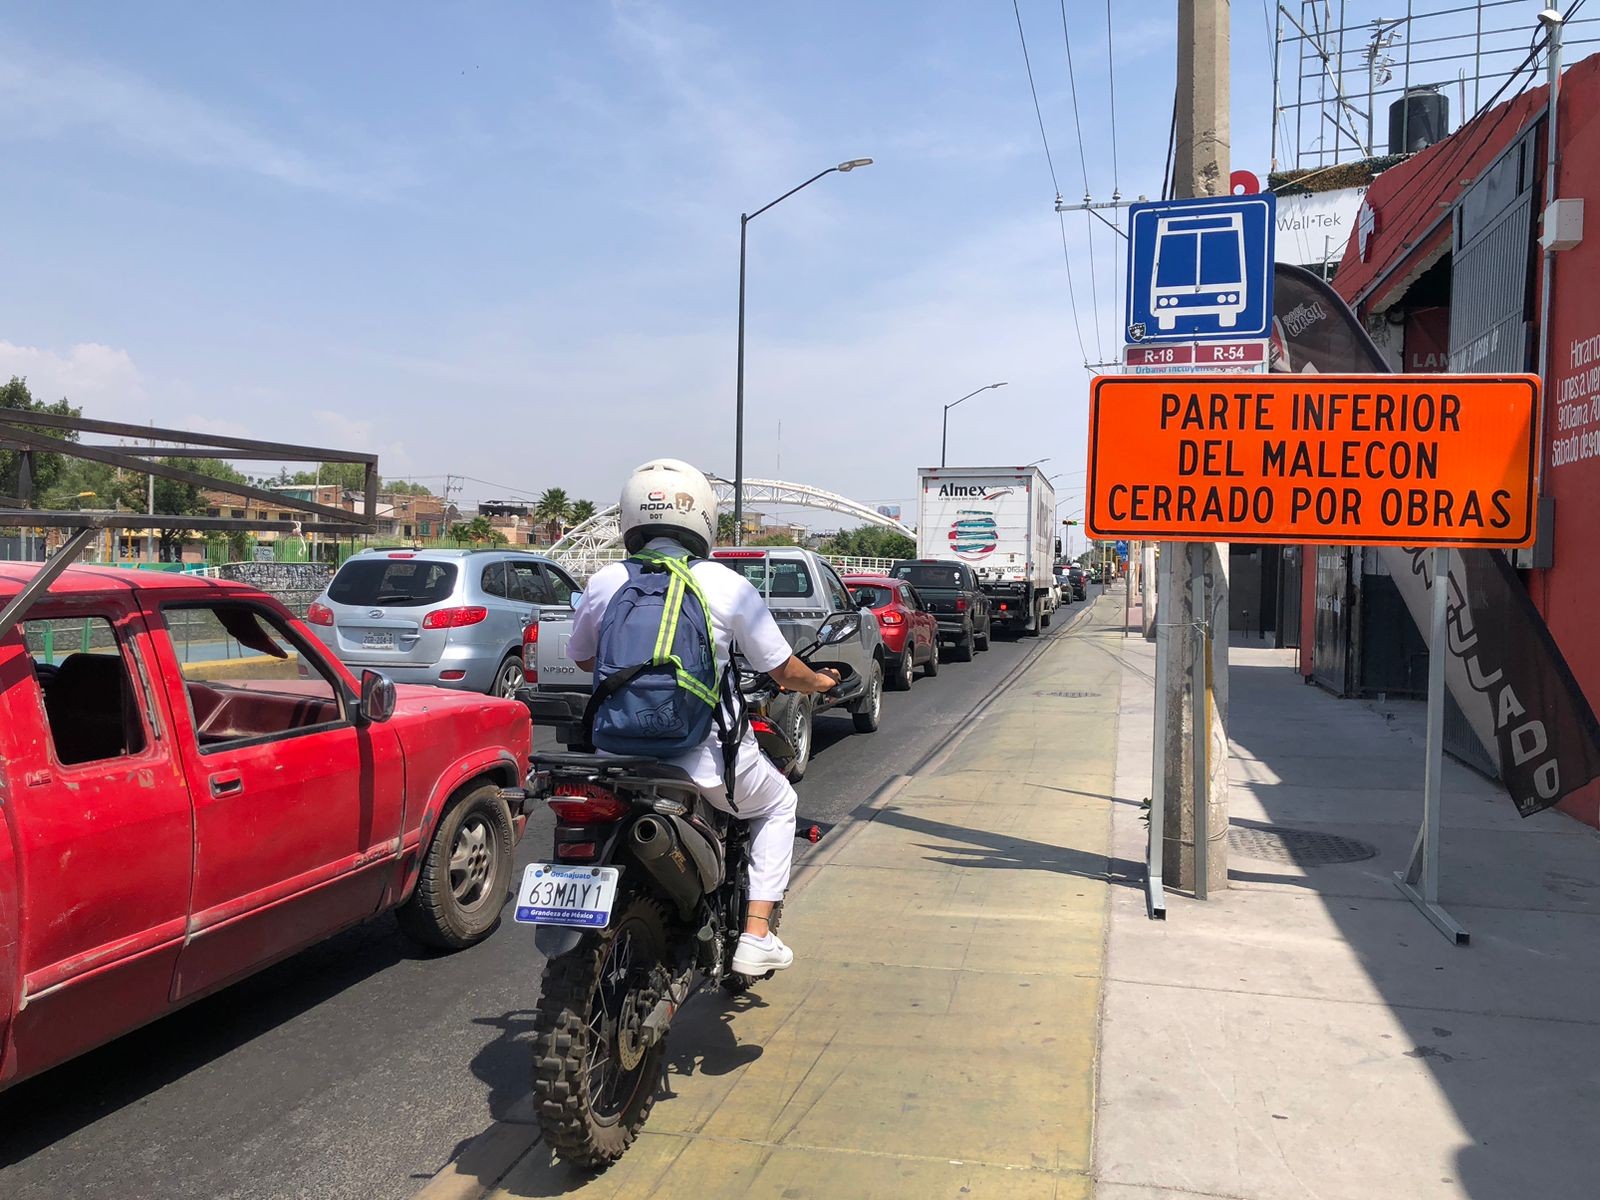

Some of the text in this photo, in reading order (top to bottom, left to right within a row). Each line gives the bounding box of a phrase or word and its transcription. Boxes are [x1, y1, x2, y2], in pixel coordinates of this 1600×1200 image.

[1144, 349, 1174, 363] R-18
[1213, 346, 1245, 360] R-54
[1160, 393, 1460, 432] PARTE INFERIOR
[1179, 440, 1438, 480] DEL MALECON
[938, 483, 987, 497] Almex
[640, 503, 674, 511] RODA
[1108, 484, 1511, 529] CERRADO POR OBRAS
[543, 666, 575, 674] NP300
[550, 870, 592, 880] Guanajuato
[529, 881, 602, 909] 63MAY1
[530, 909, 561, 917] Grandeza
